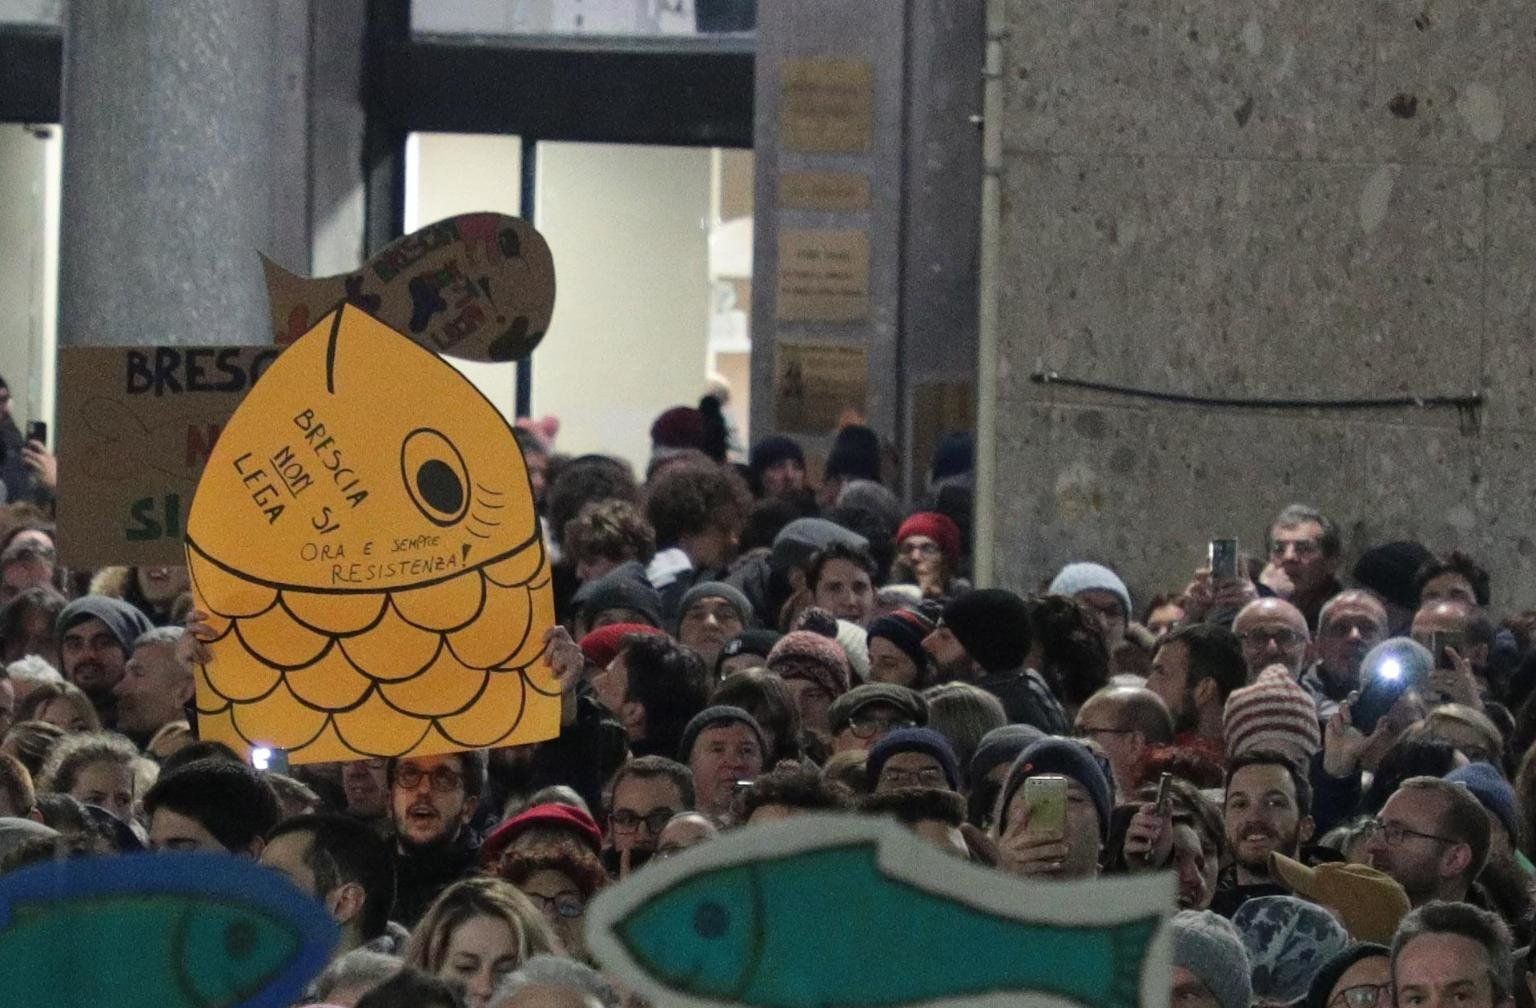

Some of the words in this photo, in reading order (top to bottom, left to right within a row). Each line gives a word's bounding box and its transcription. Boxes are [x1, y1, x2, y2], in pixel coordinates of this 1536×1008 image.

[233, 452, 285, 525] LEGA
[273, 445, 314, 495] NON
[312, 506, 340, 534] SI
[293, 408, 369, 508] BRESCIA
[300, 543, 345, 561] ORA
[364, 542, 374, 555] E
[390, 535, 441, 552] SEMPRE
